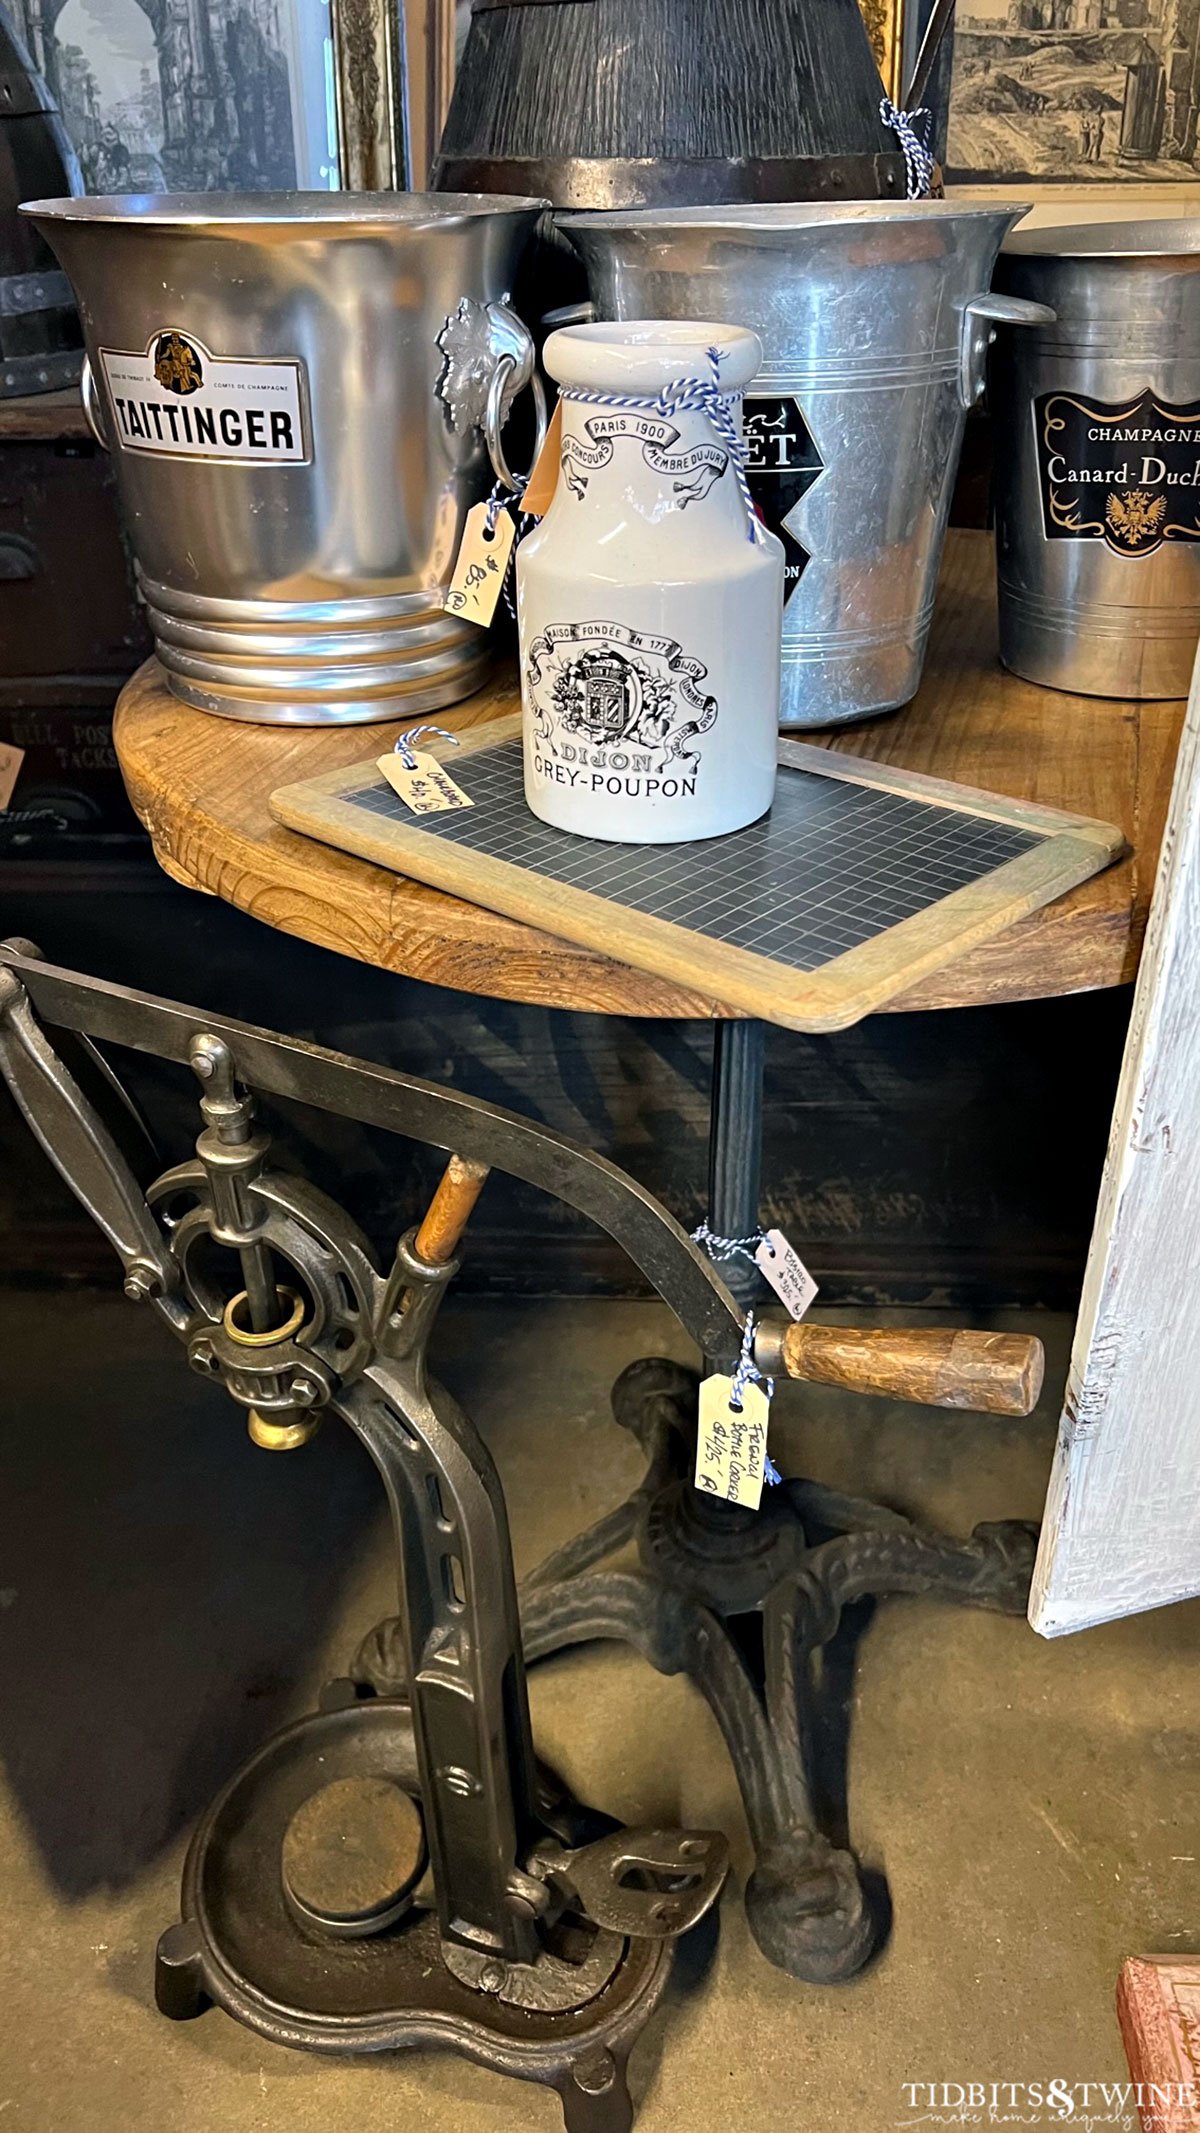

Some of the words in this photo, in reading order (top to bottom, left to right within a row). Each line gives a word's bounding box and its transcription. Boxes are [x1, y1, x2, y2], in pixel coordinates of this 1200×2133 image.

[247, 384, 289, 392] CHAMPAGNE
[115, 398, 294, 449] TAITTINGER
[593, 419, 627, 434] PARIS
[636, 421, 665, 439] 1900
[571, 443, 610, 464] CONCOURS
[647, 448, 689, 470] MEMBRE
[690, 452, 703, 465] DU
[703, 449, 727, 466] JURY
[546, 627, 577, 639] MAISON
[582, 625, 622, 638] FONDÉE
[629, 634, 643, 646] EN
[674, 658, 703, 677] DIJON
[680, 679, 704, 707] LONDRES
[700, 703, 714, 729] PARIS
[560, 741, 652, 773] DIJON
[534, 754, 697, 798] GREY-POUPON
